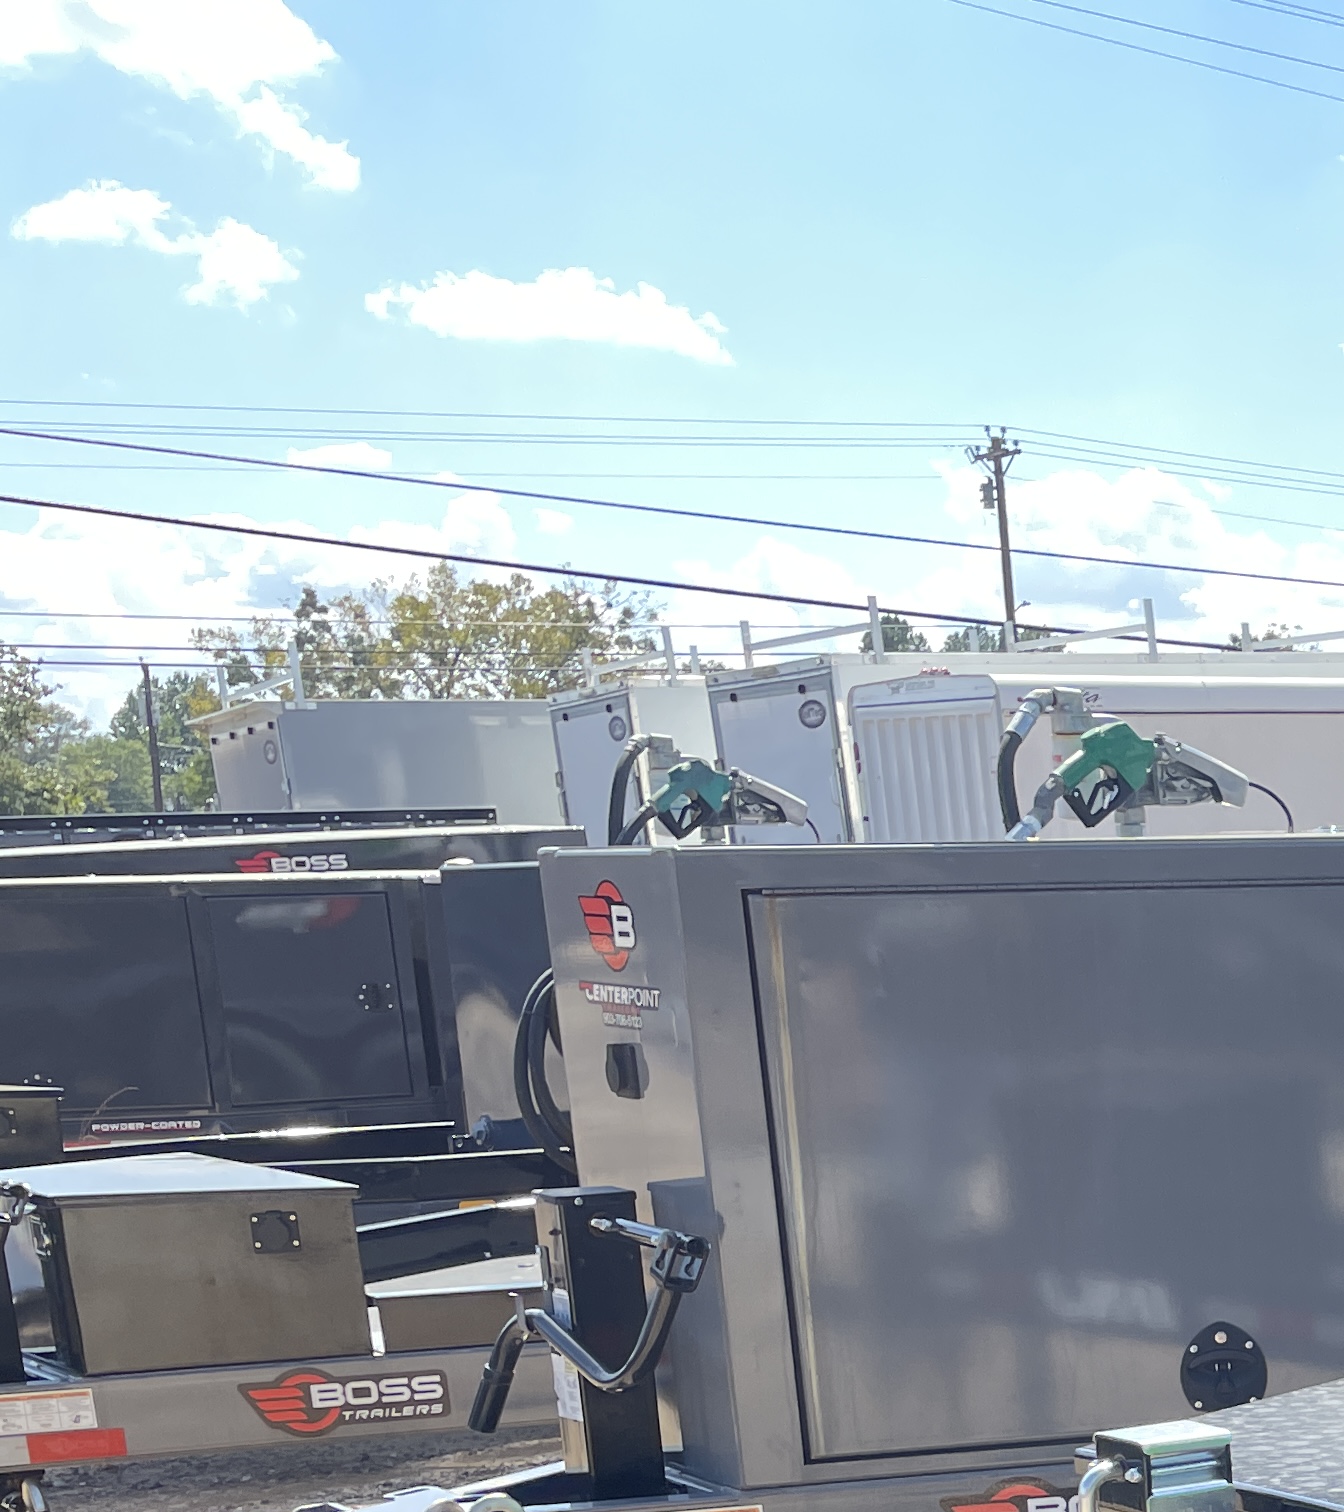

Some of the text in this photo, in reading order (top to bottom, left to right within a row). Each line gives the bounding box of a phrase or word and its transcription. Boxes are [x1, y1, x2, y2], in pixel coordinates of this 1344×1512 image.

[270, 853, 349, 873] BOSS
[585, 983, 661, 1009] CENTERPOINT
[91, 1119, 201, 1132] POWDER-COATED
[309, 1374, 445, 1409] BOSS
[341, 1403, 444, 1421] TRAILERS
